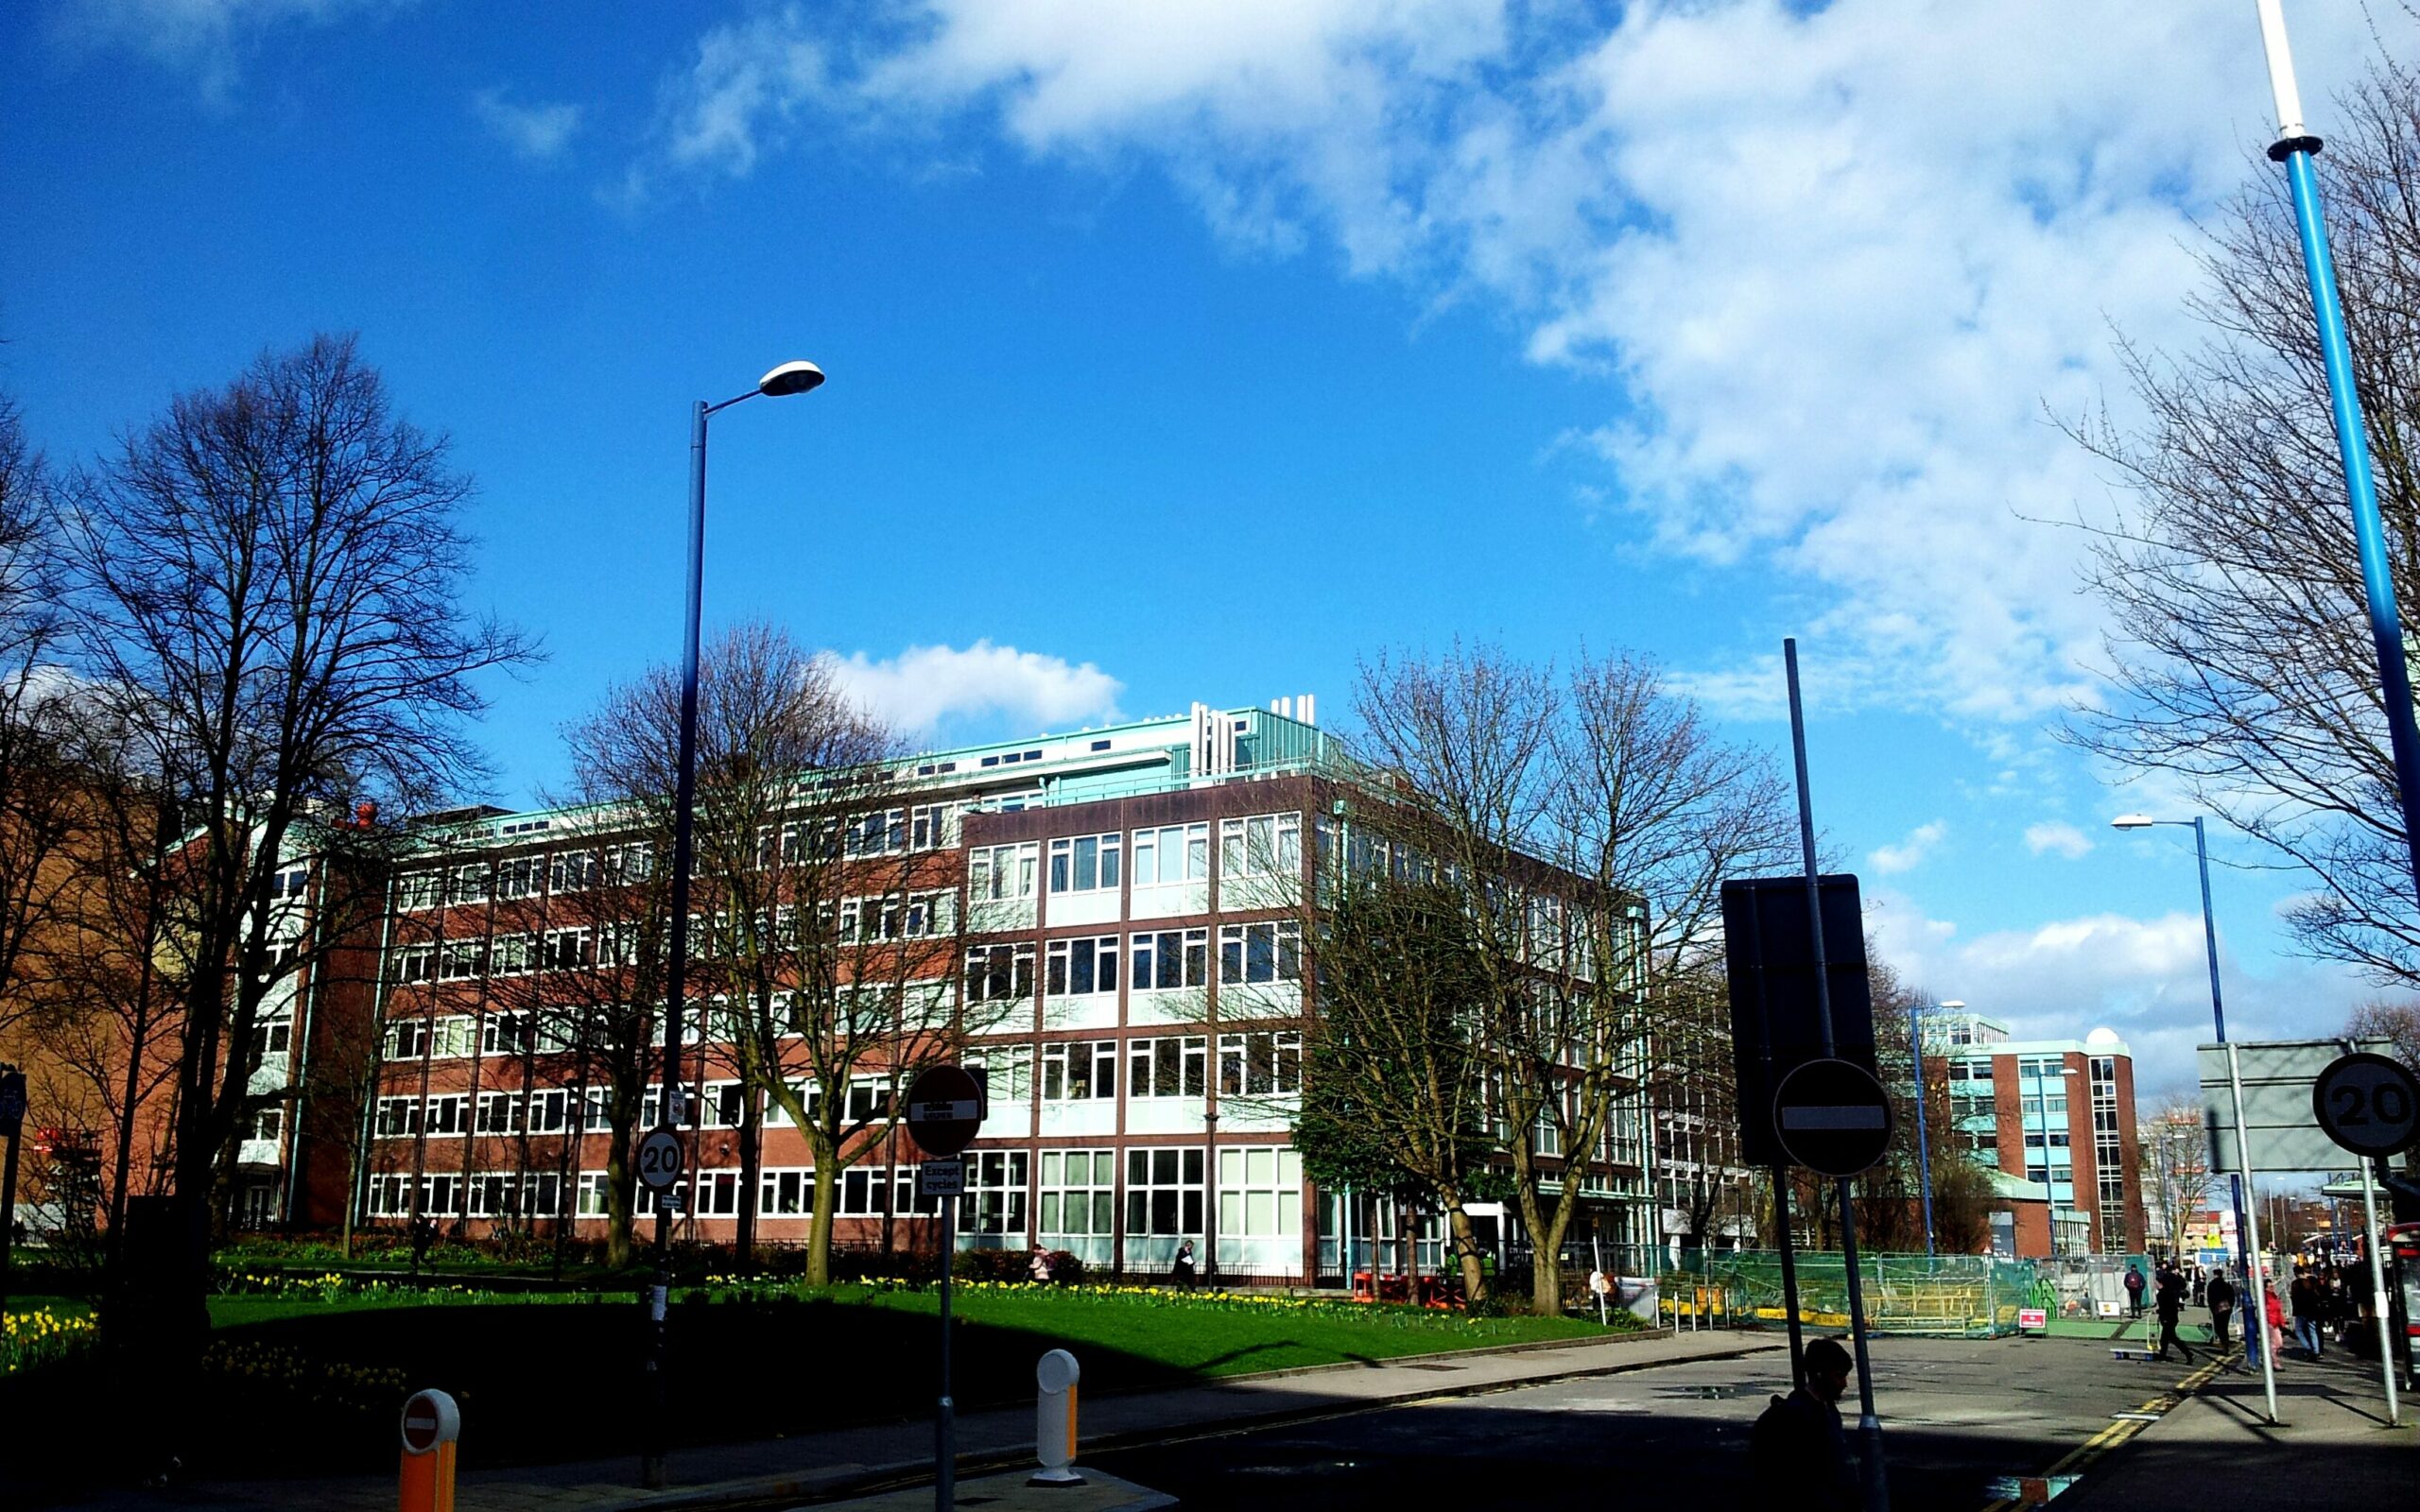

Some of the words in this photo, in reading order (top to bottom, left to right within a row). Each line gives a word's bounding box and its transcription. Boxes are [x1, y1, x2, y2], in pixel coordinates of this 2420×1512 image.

[2331, 1083, 2411, 1125] 20
[644, 1146, 678, 1174] 20
[925, 1165, 959, 1177] Except
[926, 1179, 958, 1191] cycles
